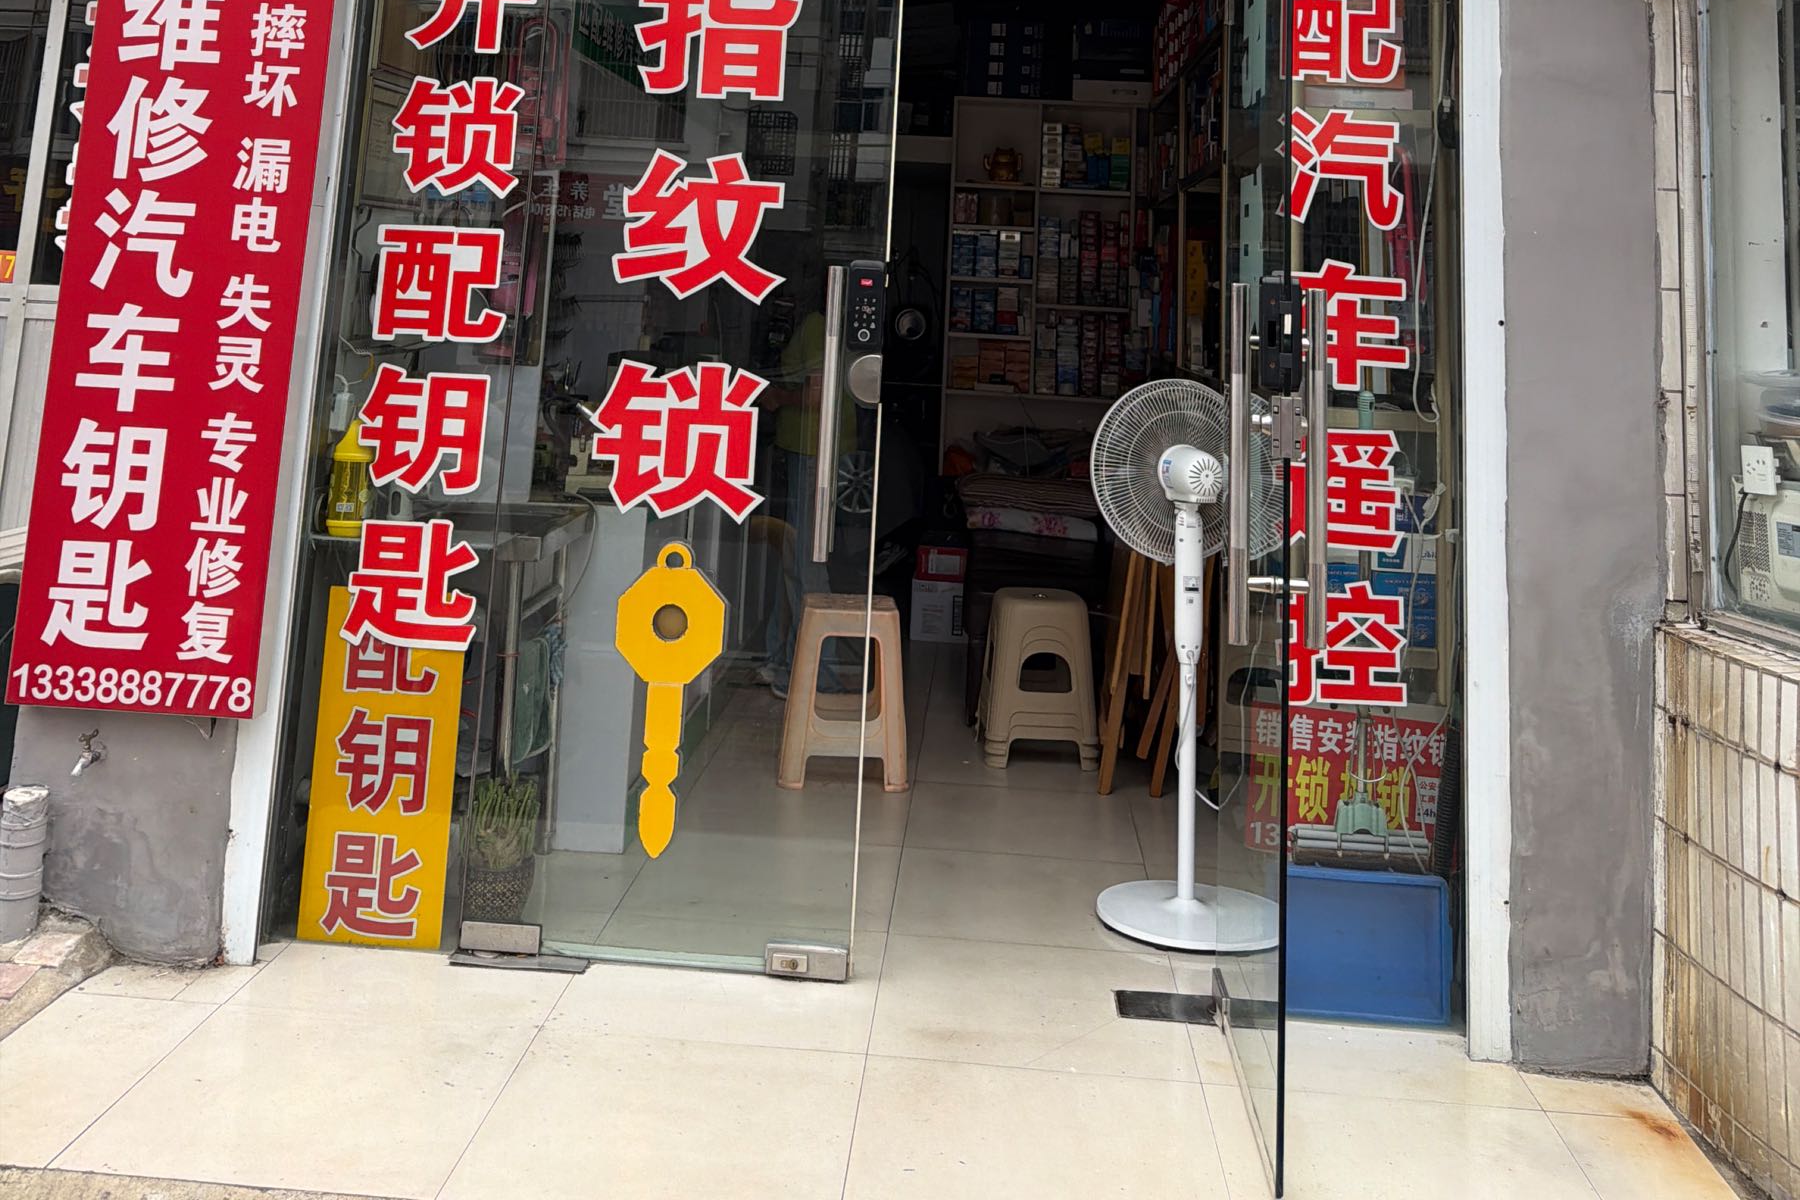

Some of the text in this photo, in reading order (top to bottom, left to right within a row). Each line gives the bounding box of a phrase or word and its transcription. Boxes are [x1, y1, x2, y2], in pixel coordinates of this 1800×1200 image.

[242, 2, 308, 117] 摔坏
[231, 137, 292, 254] 漏电
[208, 273, 272, 394] 失灵
[176, 411, 257, 664] 专业修复
[12, 663, 252, 713] 13338887778
